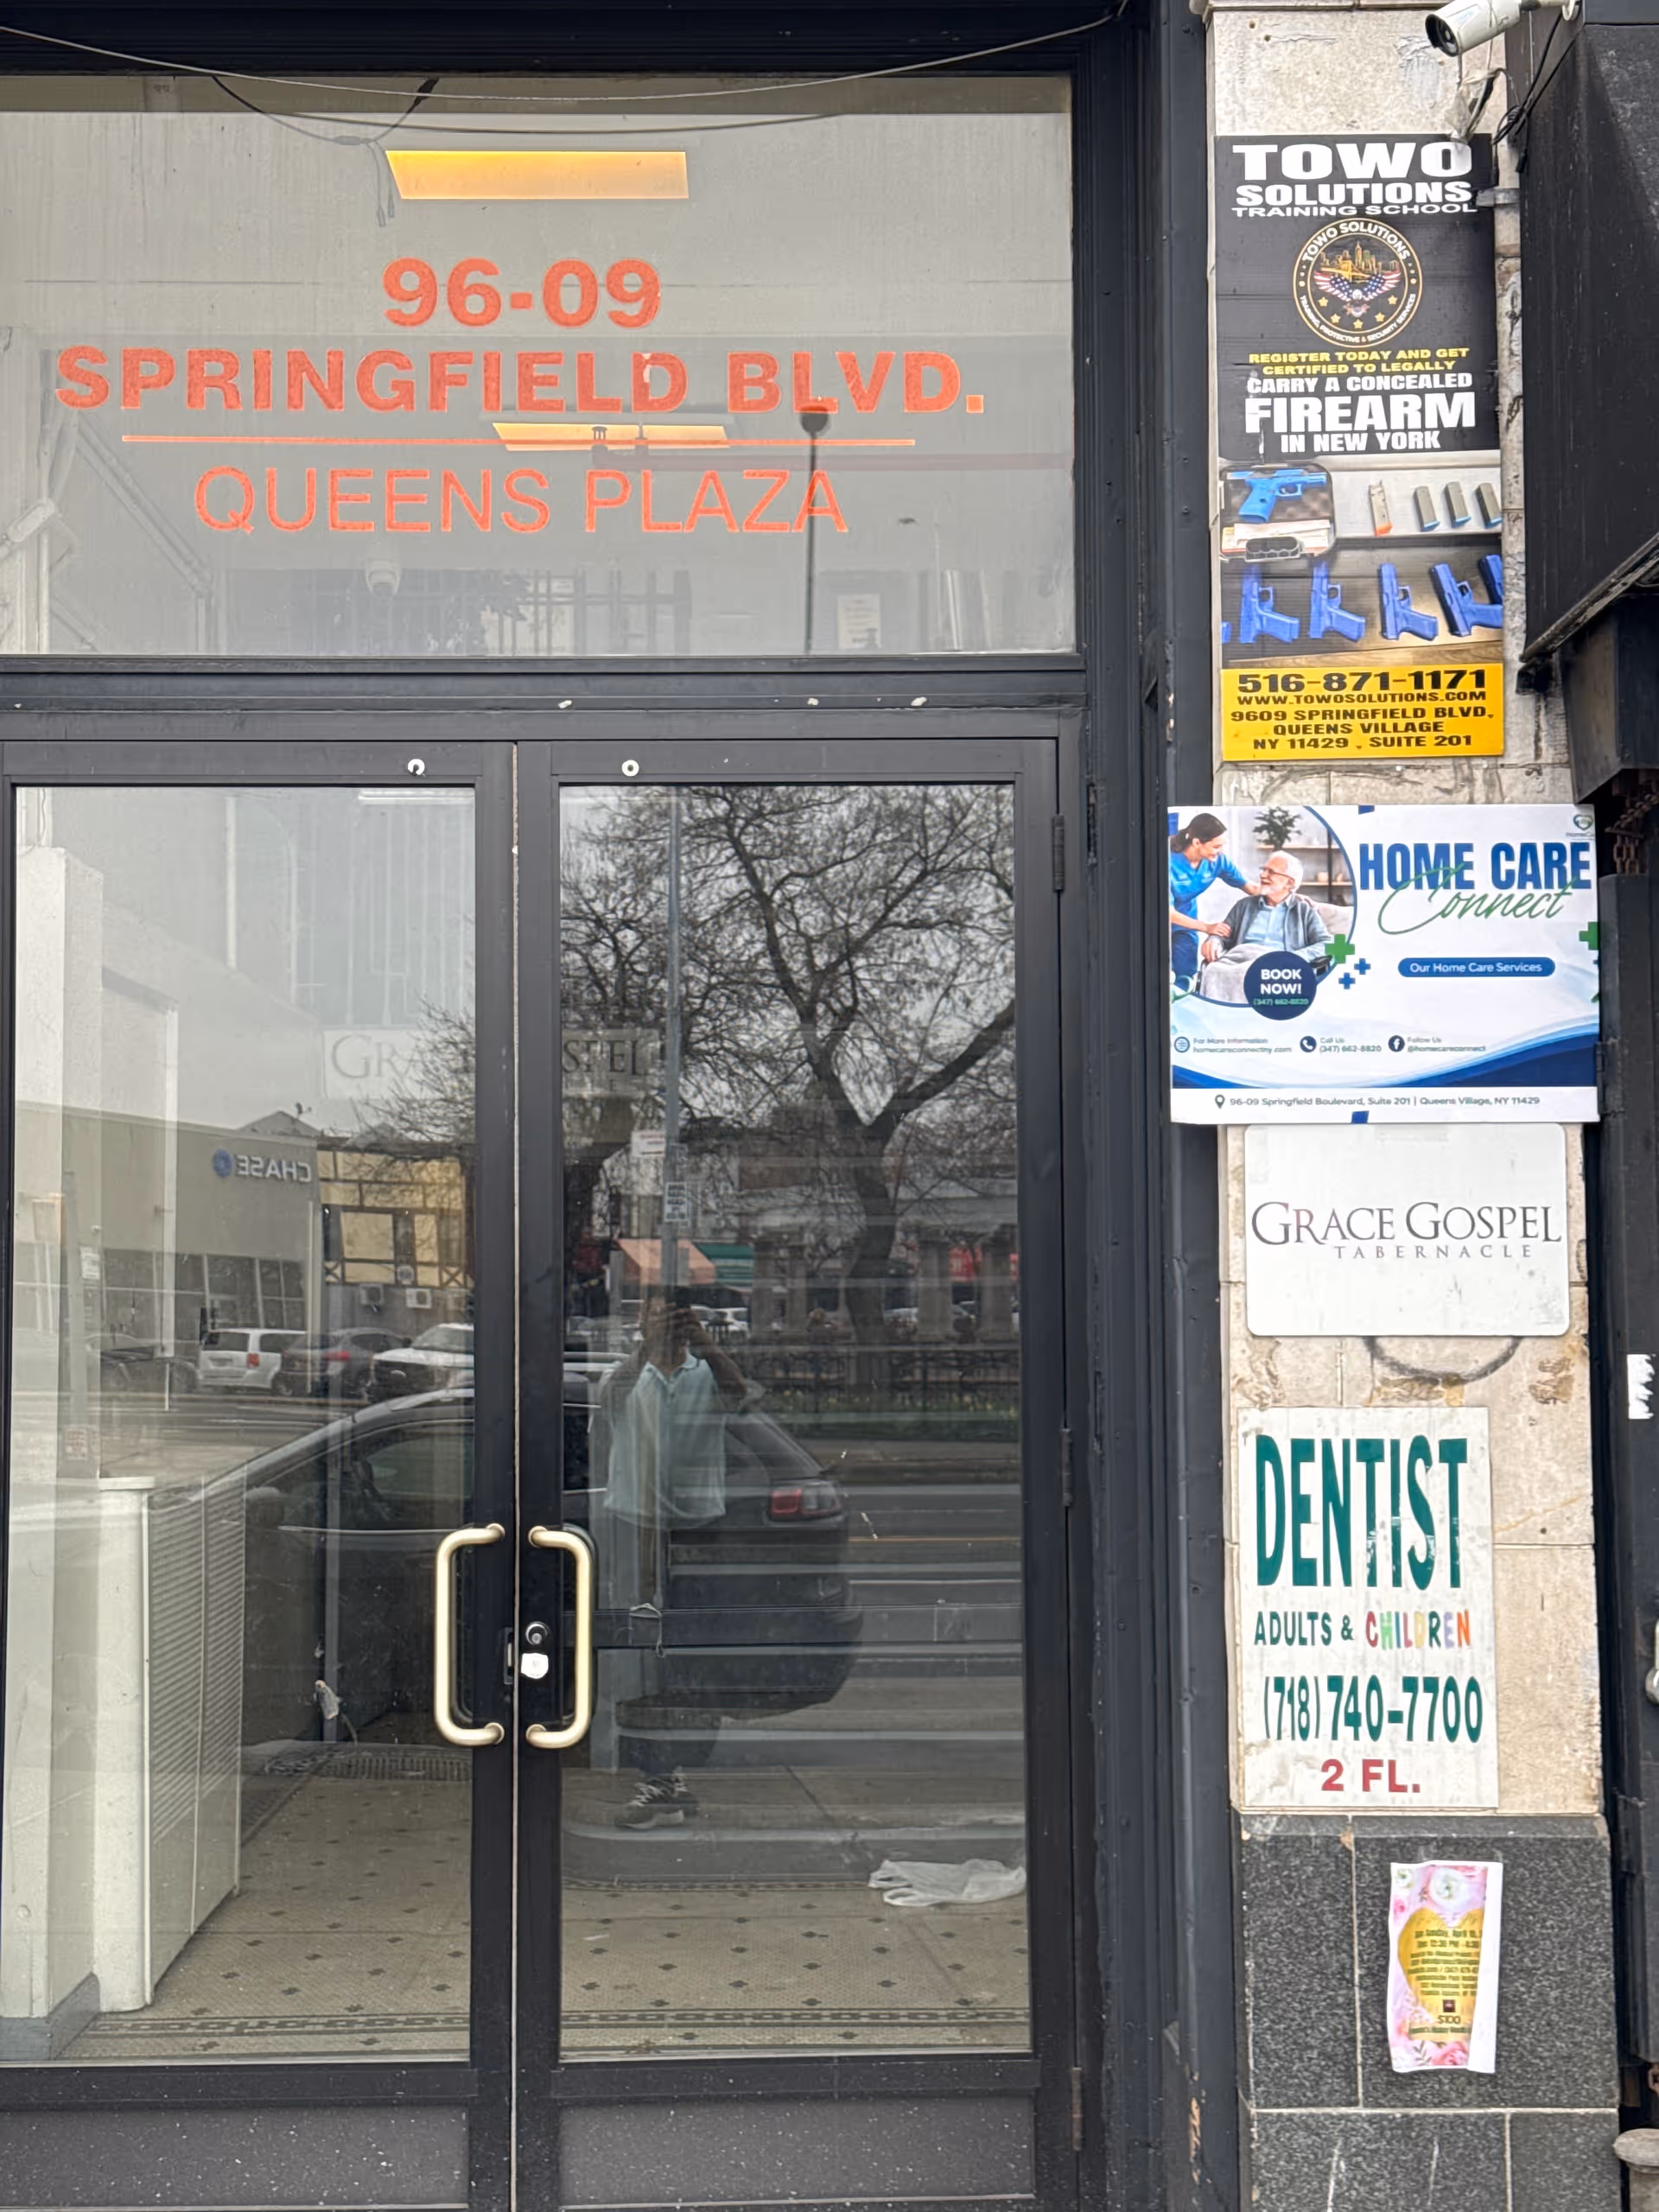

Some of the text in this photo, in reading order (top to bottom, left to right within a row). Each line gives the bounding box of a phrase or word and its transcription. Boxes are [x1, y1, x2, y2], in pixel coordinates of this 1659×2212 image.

[1232, 141, 1472, 181] TOWO
[1236, 181, 1472, 207] SOLUTIONS
[1231, 203, 1478, 218] TRAINING SCHOOL
[1302, 221, 1410, 262] TOWO SOLUTIONS
[382, 257, 661, 328] 96-09
[1249, 347, 1470, 364] REGISTER TODAY AND GET
[1262, 360, 1456, 375] CERTIFIED TO LEGALLY
[55, 345, 984, 414] SPRINGFIELD BLVD.
[1247, 372, 1473, 394] CARRY A CONCEALED
[1245, 391, 1476, 433] FIREARM
[1281, 430, 1441, 454] IN NEW YORK
[194, 466, 849, 535] QUEENS PLAZA
[1237, 669, 1486, 694] 516-871-1171
[1237, 691, 1487, 705] WWW.TOWOSOLUTIONS.COM
[1230, 710, 1287, 721] 9609
[1294, 707, 1427, 721] SPRINGFIELD
[1273, 721, 1445, 735] QUEENS VILLAGE
[1253, 738, 1280, 750] NY
[1287, 736, 1349, 749] 11429
[1369, 735, 1427, 748] SUITE
[1433, 734, 1472, 747] 201
[1358, 842, 1592, 891] HOME CARE
[1377, 861, 1578, 935] Connect
[1260, 969, 1302, 981] BOOK
[1409, 961, 1542, 973] Our Home Care Services
[1260, 982, 1302, 995] NOW!
[1262, 1097, 1313, 1107] Springfield
[1315, 1096, 1366, 1106] Boulevard,
[1368, 1096, 1392, 1105] Suite
[1394, 1096, 1411, 1105] 201
[1420, 1096, 1456, 1106] Queens
[1494, 1096, 1510, 1104] NY
[1511, 1096, 1541, 1105] 11429
[1334, 1244, 1532, 1260] TABERNACLE
[1255, 1434, 1467, 1591] DENTIST
[1254, 1610, 1471, 1650] ADULTS & CHILDREN
[1263, 1674, 1484, 1743] (718) 740-7700
[1321, 1758, 1421, 1793] 2 FL.
